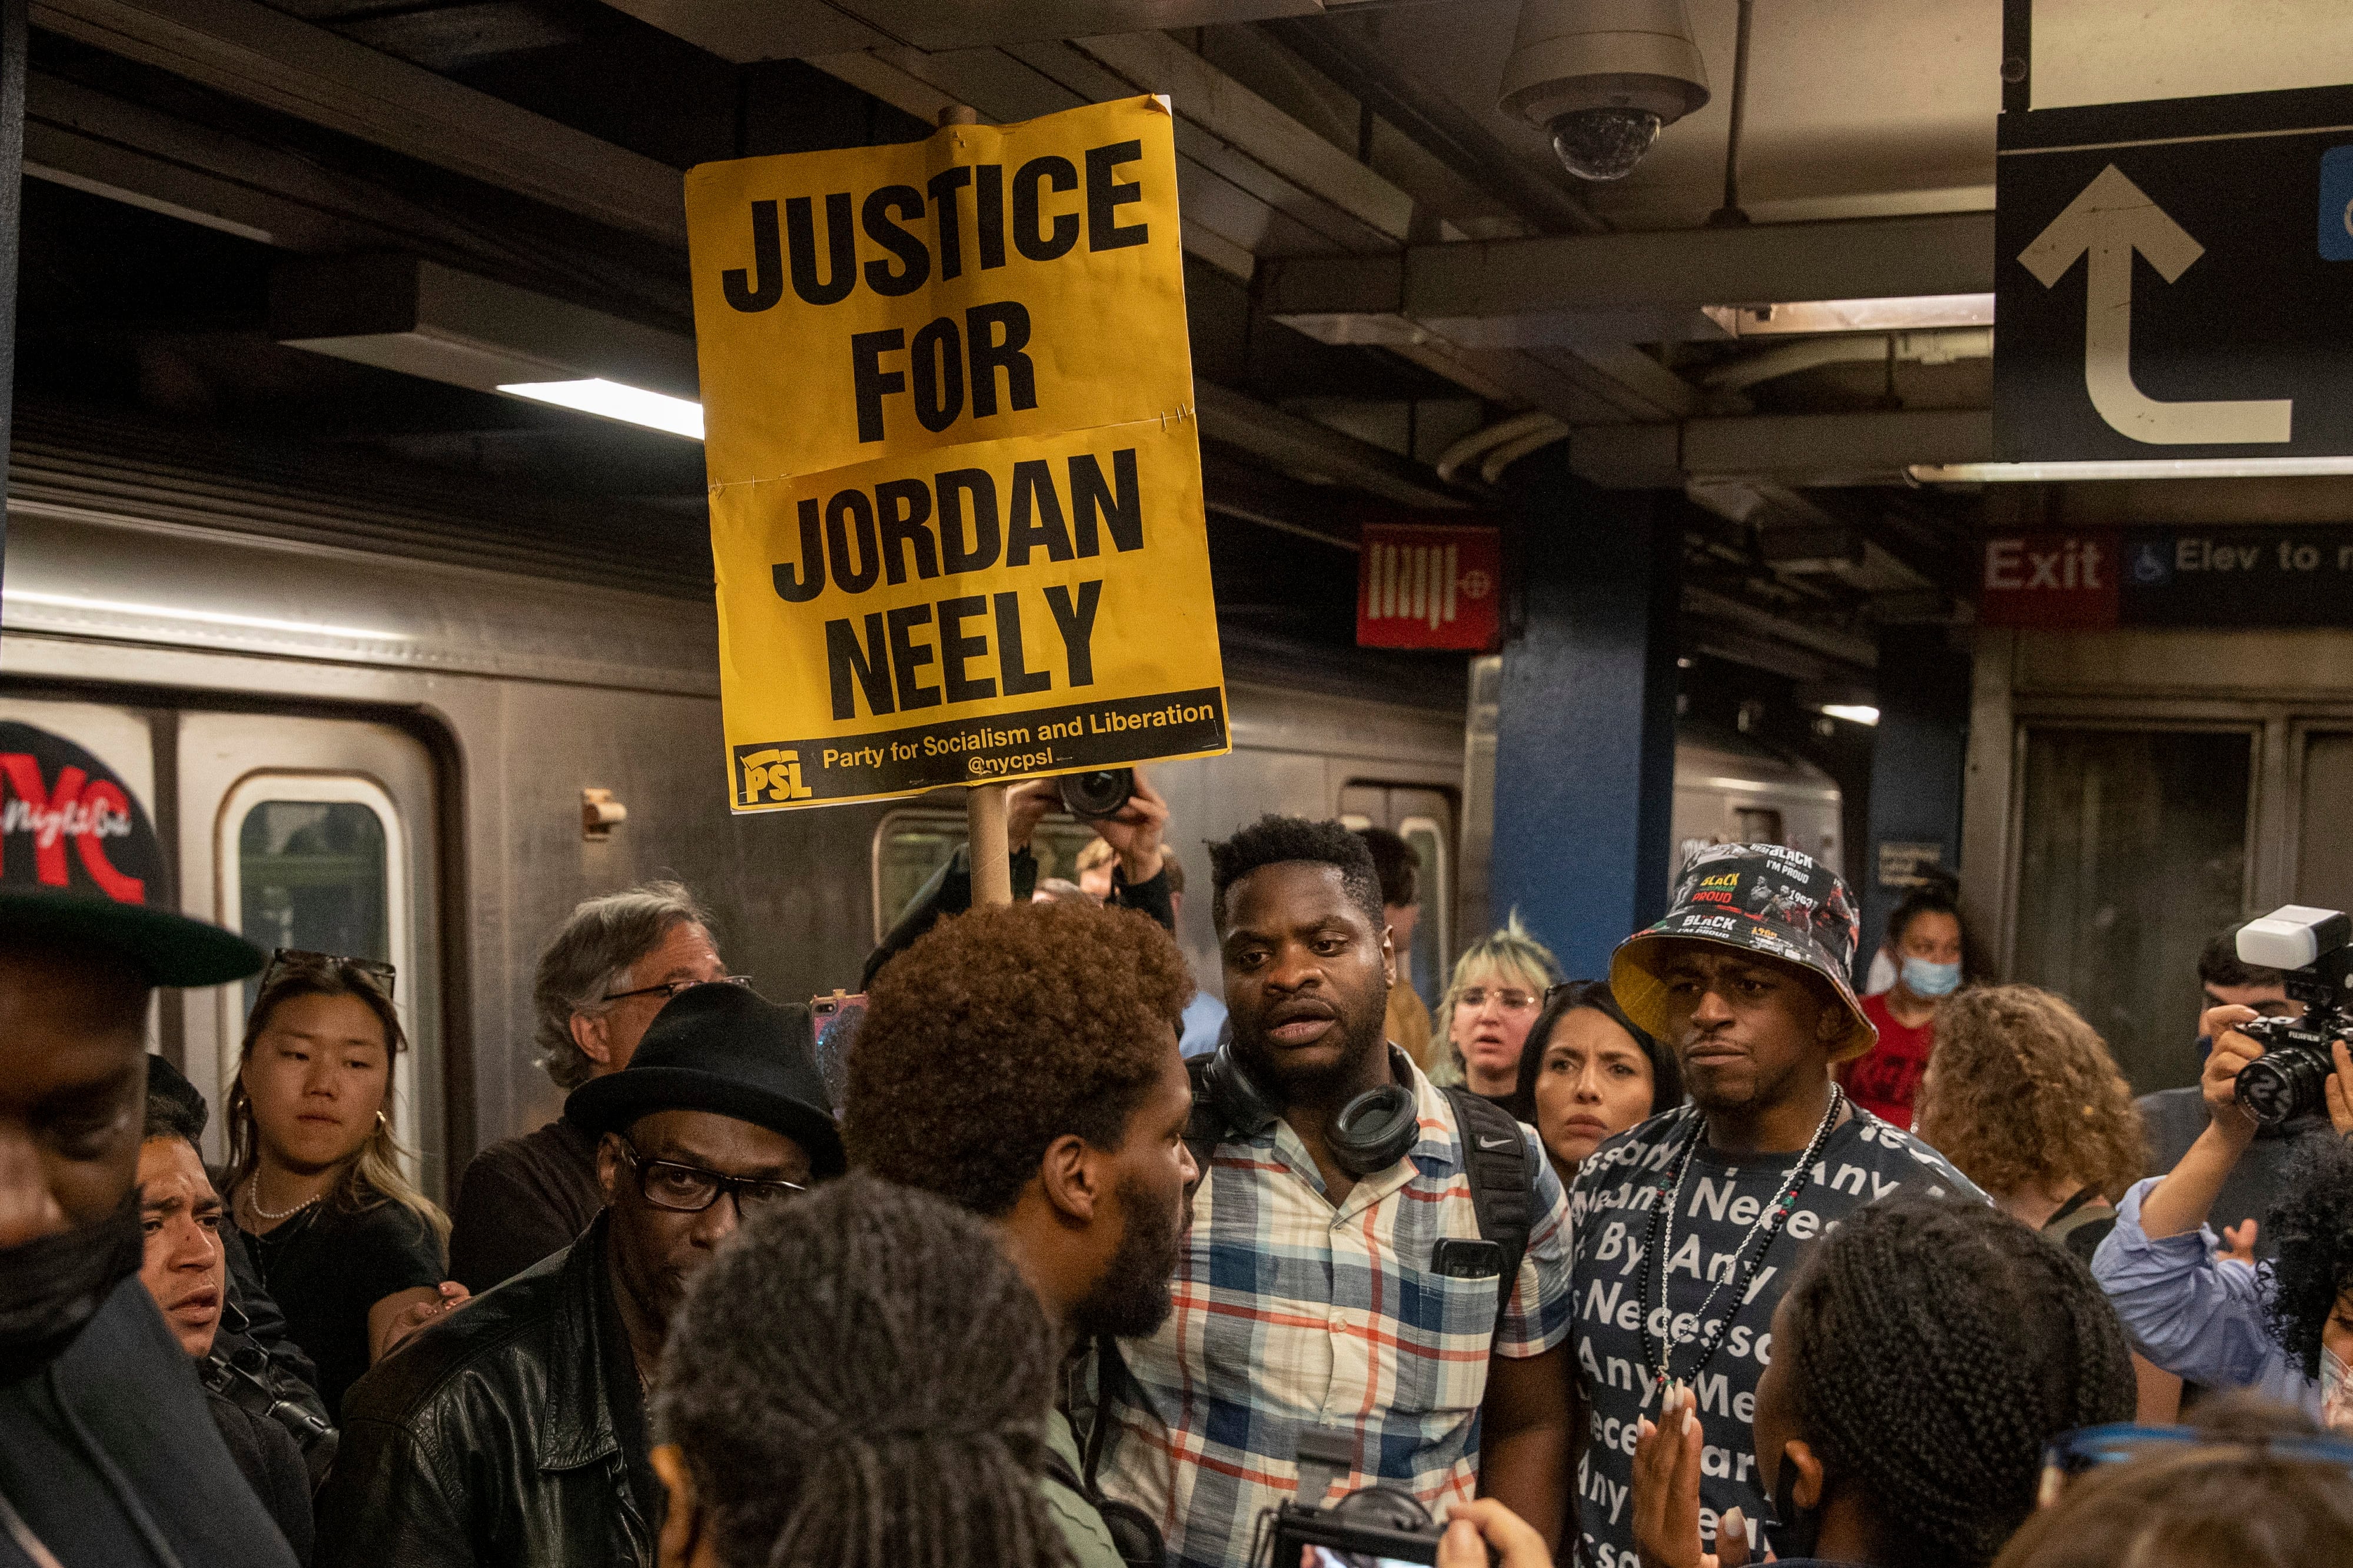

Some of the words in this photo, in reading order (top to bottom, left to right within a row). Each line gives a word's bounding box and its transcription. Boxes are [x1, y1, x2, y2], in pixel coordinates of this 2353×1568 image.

[722, 139, 1148, 313] JUSTICE
[851, 301, 1038, 444] FOR
[772, 448, 1144, 602] JORDAN
[1985, 539, 2104, 589] Exit
[2177, 538, 2260, 570] Elev
[2279, 540, 2319, 570] to
[825, 580, 1102, 720] NEELY
[823, 747, 884, 769] Party
[890, 741, 918, 761] for
[923, 726, 1031, 757] Socialism
[1038, 715, 1083, 741] and
[1090, 703, 1214, 735] Liberation
[968, 747, 1053, 775] @nycpsl
[745, 761, 812, 803] PSL
[1766, 860, 1782, 872] I'M
[1782, 865, 1810, 884] PROUD
[1768, 847, 1813, 869] BLACK
[1691, 891, 1733, 904] PROUD
[1700, 873, 1740, 886] BLACK
[1682, 914, 1737, 931] BLACK
[1695, 929, 1729, 939] PROUD
[2288, 1031, 2320, 1042] FUJIFILM
[1577, 1139, 1684, 1176] ssary
[1687, 1168, 1842, 1240] Nece
[1596, 1222, 1648, 1276] By
[1667, 1233, 1777, 1305] Any
[1578, 1336, 1657, 1408] Any
